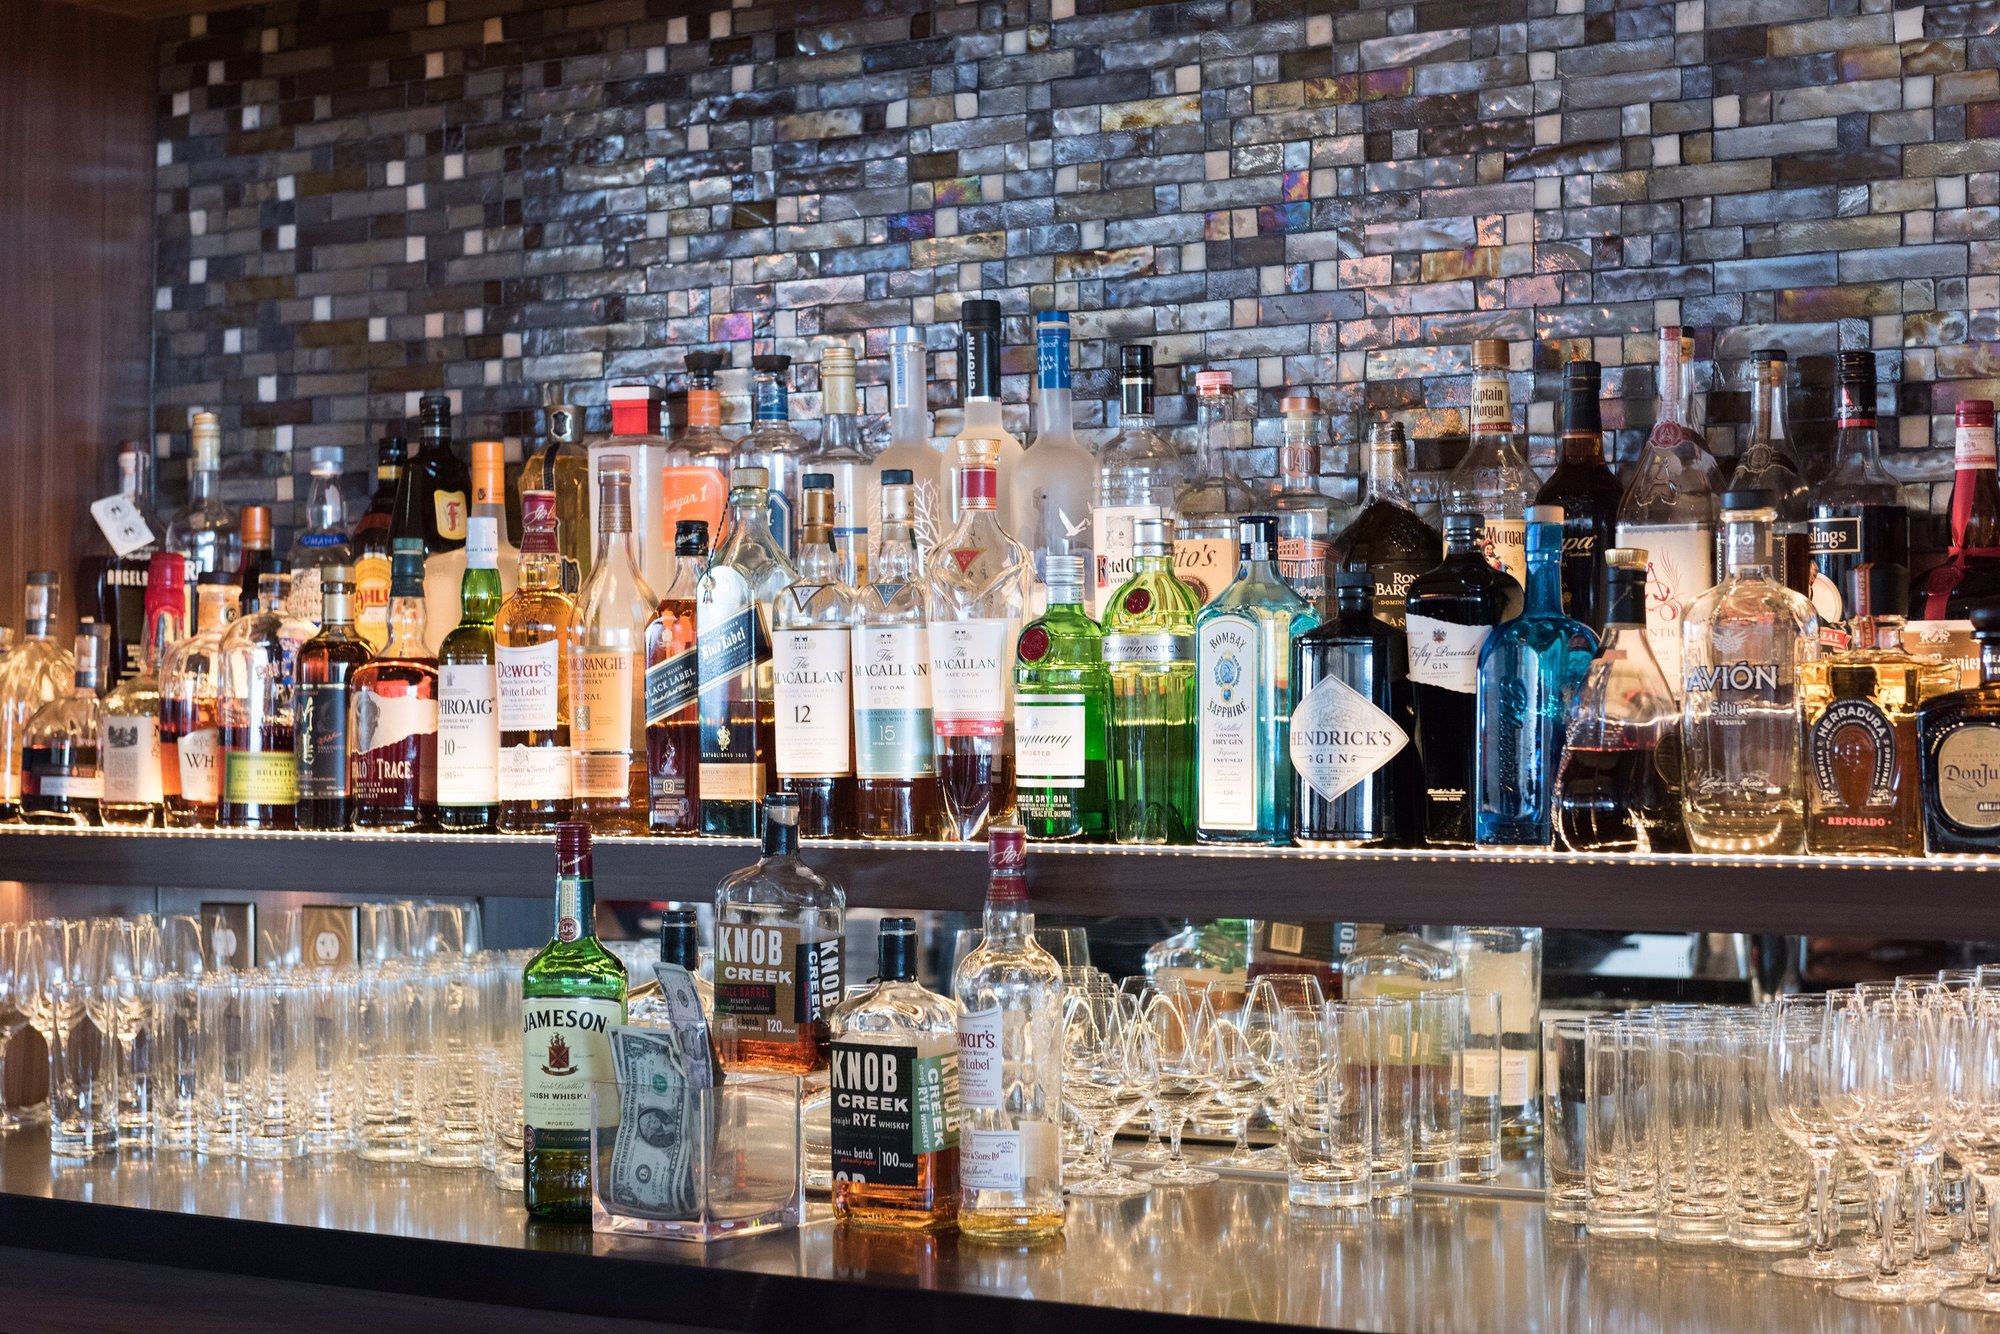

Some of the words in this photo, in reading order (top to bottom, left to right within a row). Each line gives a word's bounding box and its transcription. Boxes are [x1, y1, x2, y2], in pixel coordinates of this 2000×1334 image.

[968, 336, 976, 390] CHOPIN
[1472, 387, 1503, 402] Captain
[1473, 404, 1504, 418] Morgan
[1098, 558, 1124, 583] Ketel
[702, 642, 720, 660] Blue
[720, 626, 746, 648] Label
[1210, 632, 1248, 651] BOMBAY
[874, 649, 894, 662] The
[952, 647, 967, 658] The
[1409, 644, 1432, 666] Fifty
[1434, 644, 1476, 658] Pounds
[498, 662, 552, 678] Dewar's
[791, 656, 809, 669] The
[855, 663, 927, 677] MACALLAN
[935, 659, 996, 669] MACALLAN
[646, 683, 668, 698] BLACK
[670, 668, 696, 686] LABEL
[774, 670, 844, 684] MACALLAN
[1687, 660, 1778, 692] AVIÓN
[794, 705, 811, 723] 12
[1207, 700, 1249, 718] SAPPHIRE
[1710, 701, 1749, 716] Silver
[1214, 722, 1241, 731] Distilled
[1818, 706, 1886, 737] HERRADURA
[880, 725, 896, 740] 15
[1291, 730, 1391, 746] HENDRICK'S
[444, 739, 455, 756] 10
[1316, 754, 1348, 764] GIN
[1880, 747, 1890, 786] ORIGINAL
[1818, 750, 1829, 788] TEQUILA
[665, 782, 673, 791] 12
[1828, 817, 1885, 826] REPOSADO
[720, 926, 783, 966] KNOB
[725, 966, 792, 984] CREEK
[820, 939, 840, 1008] KNOB
[740, 986, 770, 998] BARREL
[808, 951, 821, 1020] CREEK
[524, 1010, 607, 1034] JAMESON
[741, 1016, 759, 1025] batch
[767, 1019, 782, 1033] 120
[832, 1050, 898, 1093] KNOB
[554, 1082, 585, 1090] Distilled
[838, 1094, 909, 1112] CREEK
[918, 1087, 929, 1111] RYE
[928, 1068, 944, 1147] CREEK
[675, 1102, 684, 1141] DOLLAR
[853, 1113, 876, 1127] RYE
[879, 1121, 909, 1130] WHISKEY
[920, 1114, 929, 1149] WHISKEY
[854, 1147, 873, 1159] batch
[882, 1152, 899, 1167] 100
[975, 1152, 990, 1160] Sons
